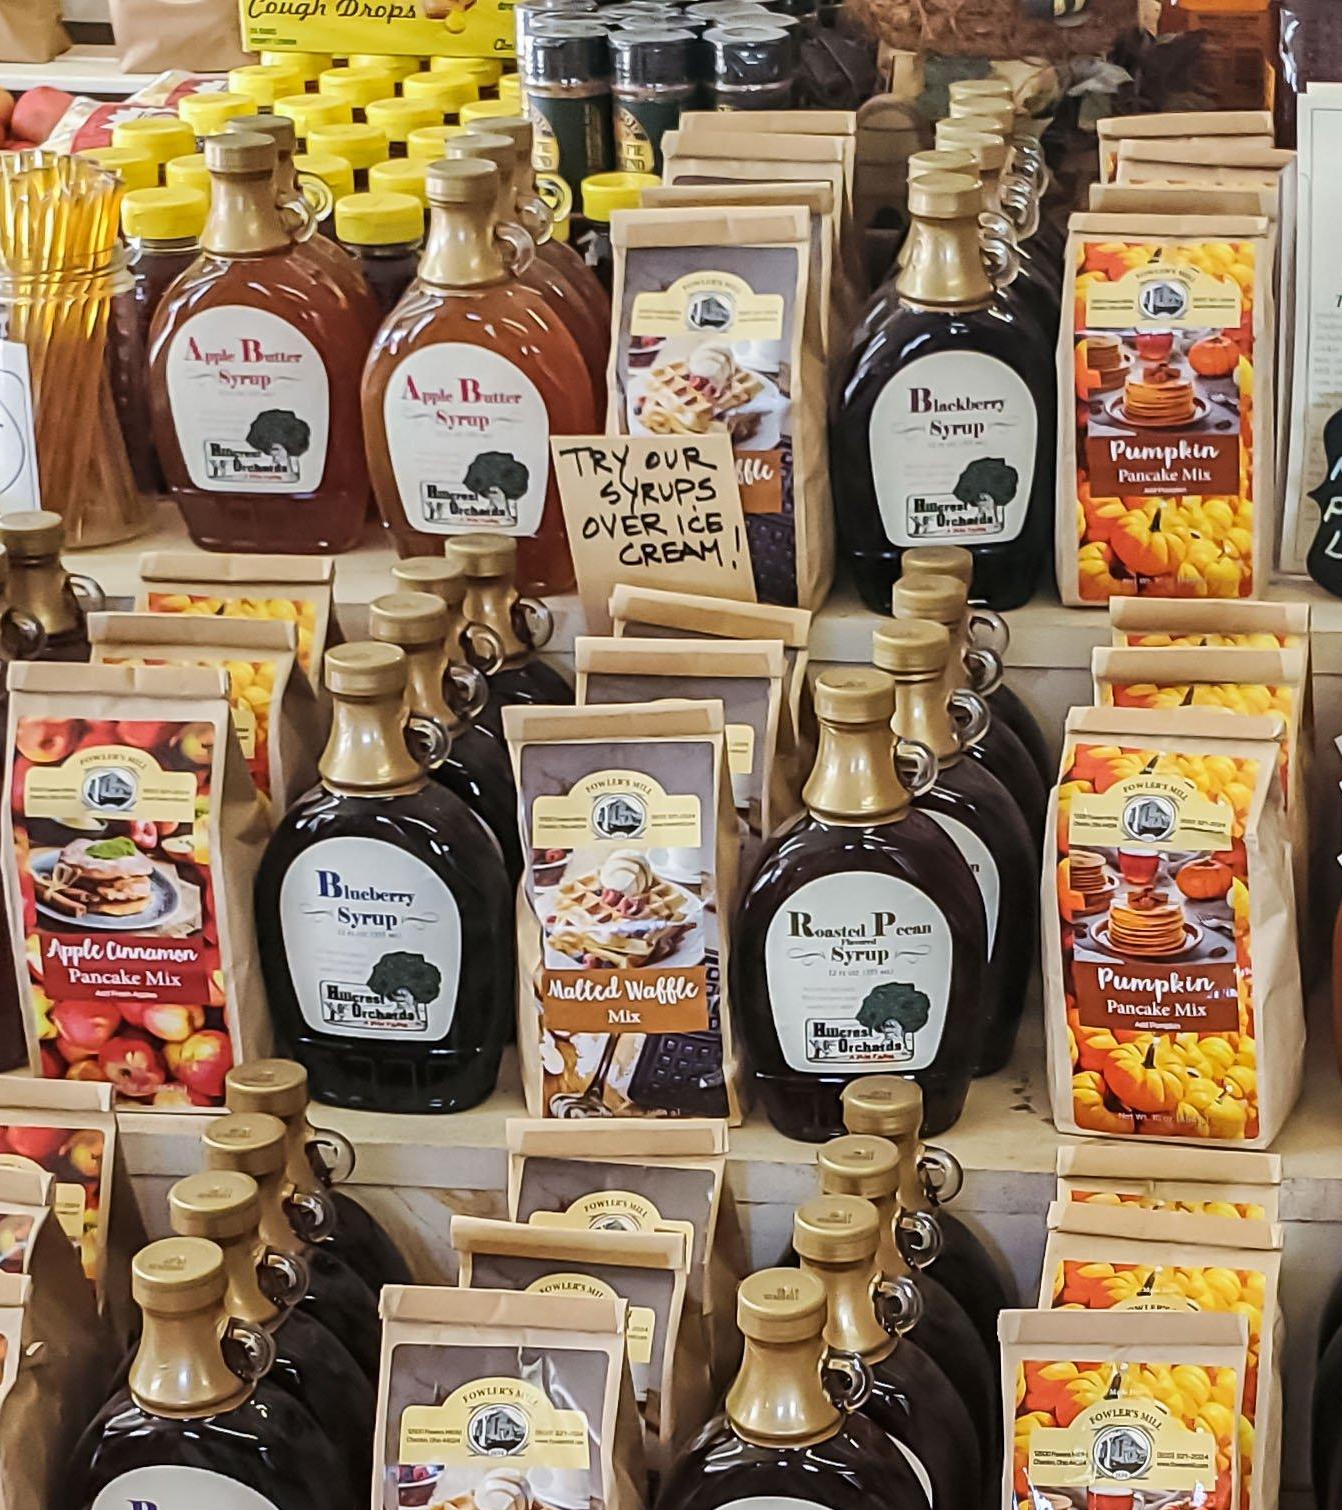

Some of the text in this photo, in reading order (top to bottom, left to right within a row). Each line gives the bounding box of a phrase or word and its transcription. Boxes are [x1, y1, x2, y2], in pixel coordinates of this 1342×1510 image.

[184, 337, 302, 365] Apple Butter
[219, 370, 271, 389] Syrup
[402, 374, 522, 406] Apple Butter
[909, 387, 1006, 414] Blackberry
[436, 410, 490, 431] Syrup
[930, 420, 984, 439] Syrup
[559, 444, 717, 483] TRY OUR
[1110, 439, 1219, 469] Pumpkin
[1118, 468, 1212, 484] Pancake Mix
[600, 477, 716, 514] SYRUPS
[583, 512, 723, 539] OVER ICE
[316, 870, 416, 907] Blueberry
[338, 907, 397, 929] Syrup
[787, 911, 931, 938] Roasted Pecan
[47, 938, 198, 969] Apple Cinnamon
[831, 946, 889, 966] Syrup
[69, 968, 181, 987] Pancake Mix
[547, 976, 699, 1005] Malted Waffle
[1097, 967, 1215, 1003] Pumpkin
[608, 1010, 641, 1024] Mix
[1107, 1000, 1207, 1018] Pancake Mix
